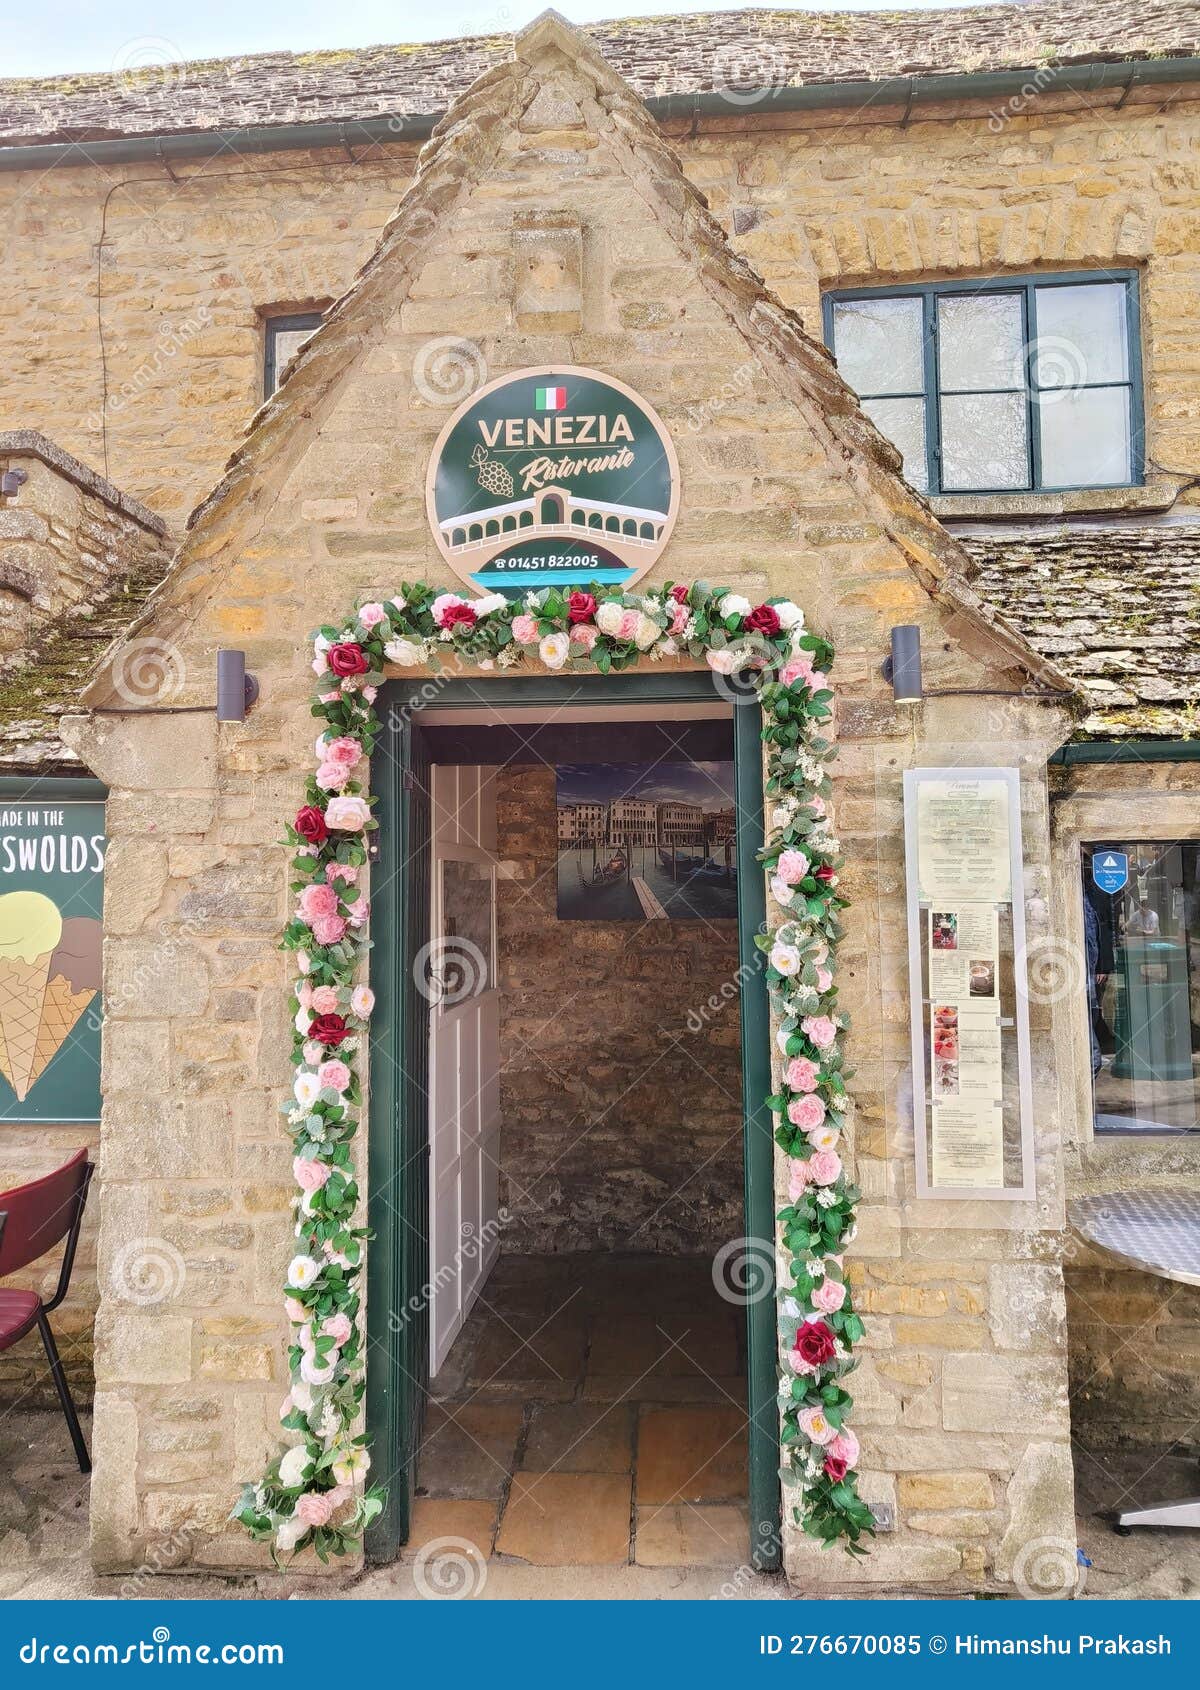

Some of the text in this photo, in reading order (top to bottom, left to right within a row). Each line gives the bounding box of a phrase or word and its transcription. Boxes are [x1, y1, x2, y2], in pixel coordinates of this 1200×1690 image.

[478, 414, 635, 447] VENEZIA
[519, 446, 635, 492] Ristorante
[508, 555, 598, 569] 01451 822005
[0, 810, 64, 827] ADE IN THE
[0, 835, 105, 873] SWOLDS
